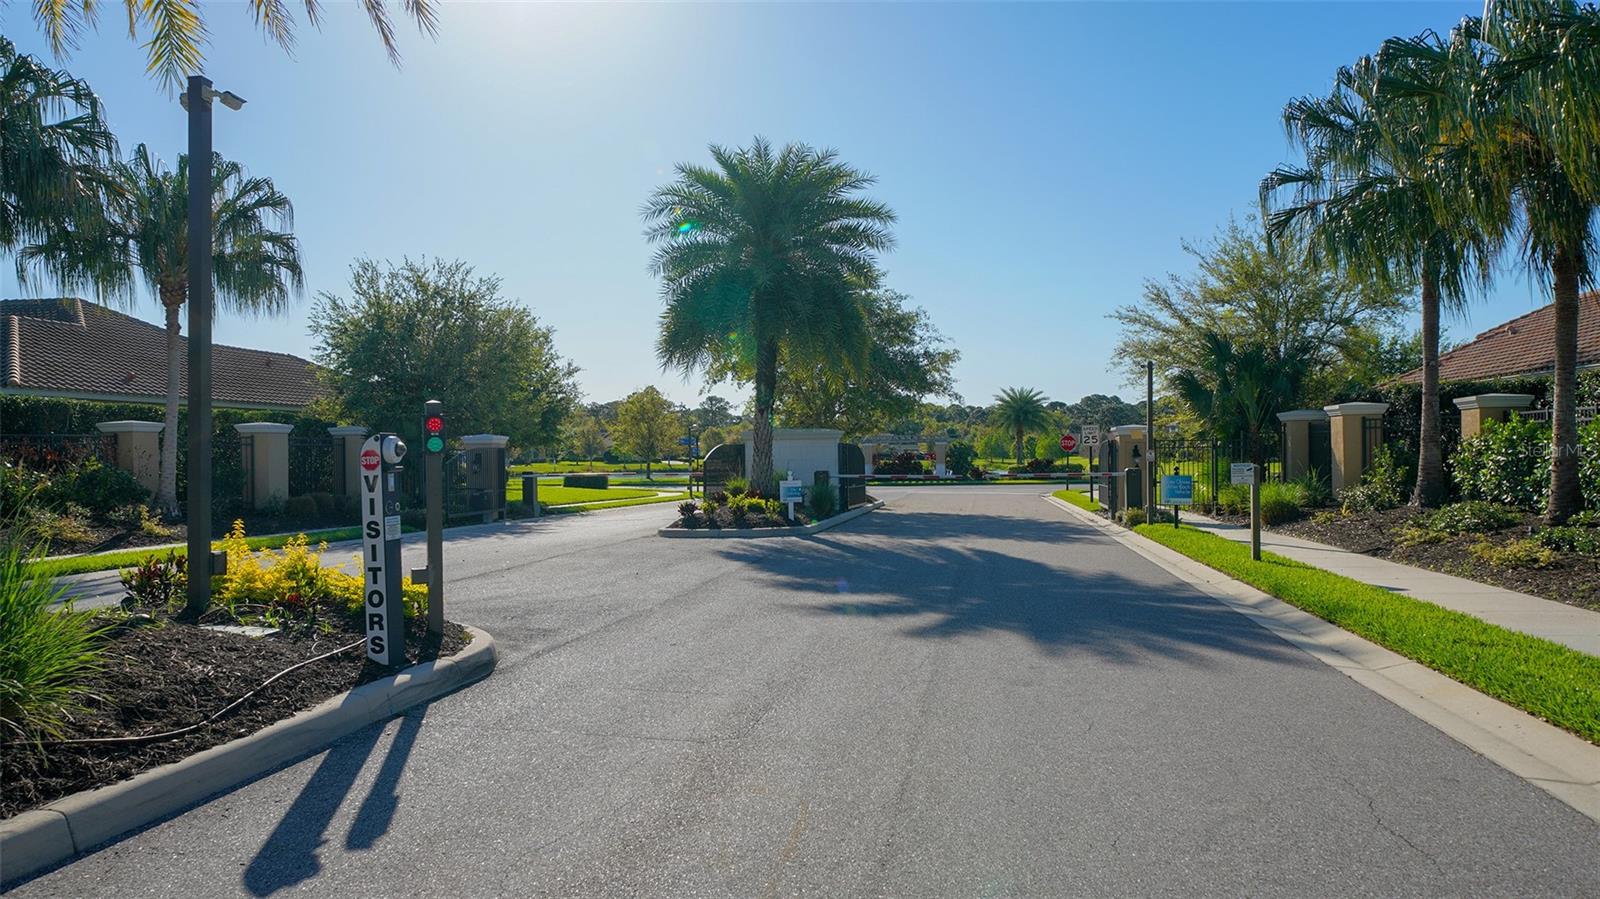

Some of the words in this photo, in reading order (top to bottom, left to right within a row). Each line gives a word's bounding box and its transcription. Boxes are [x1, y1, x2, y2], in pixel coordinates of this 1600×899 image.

[1061, 439, 1076, 447] STOP
[1083, 435, 1099, 444] 25
[361, 455, 380, 465] STOP
[364, 475, 385, 654] VISITORS
